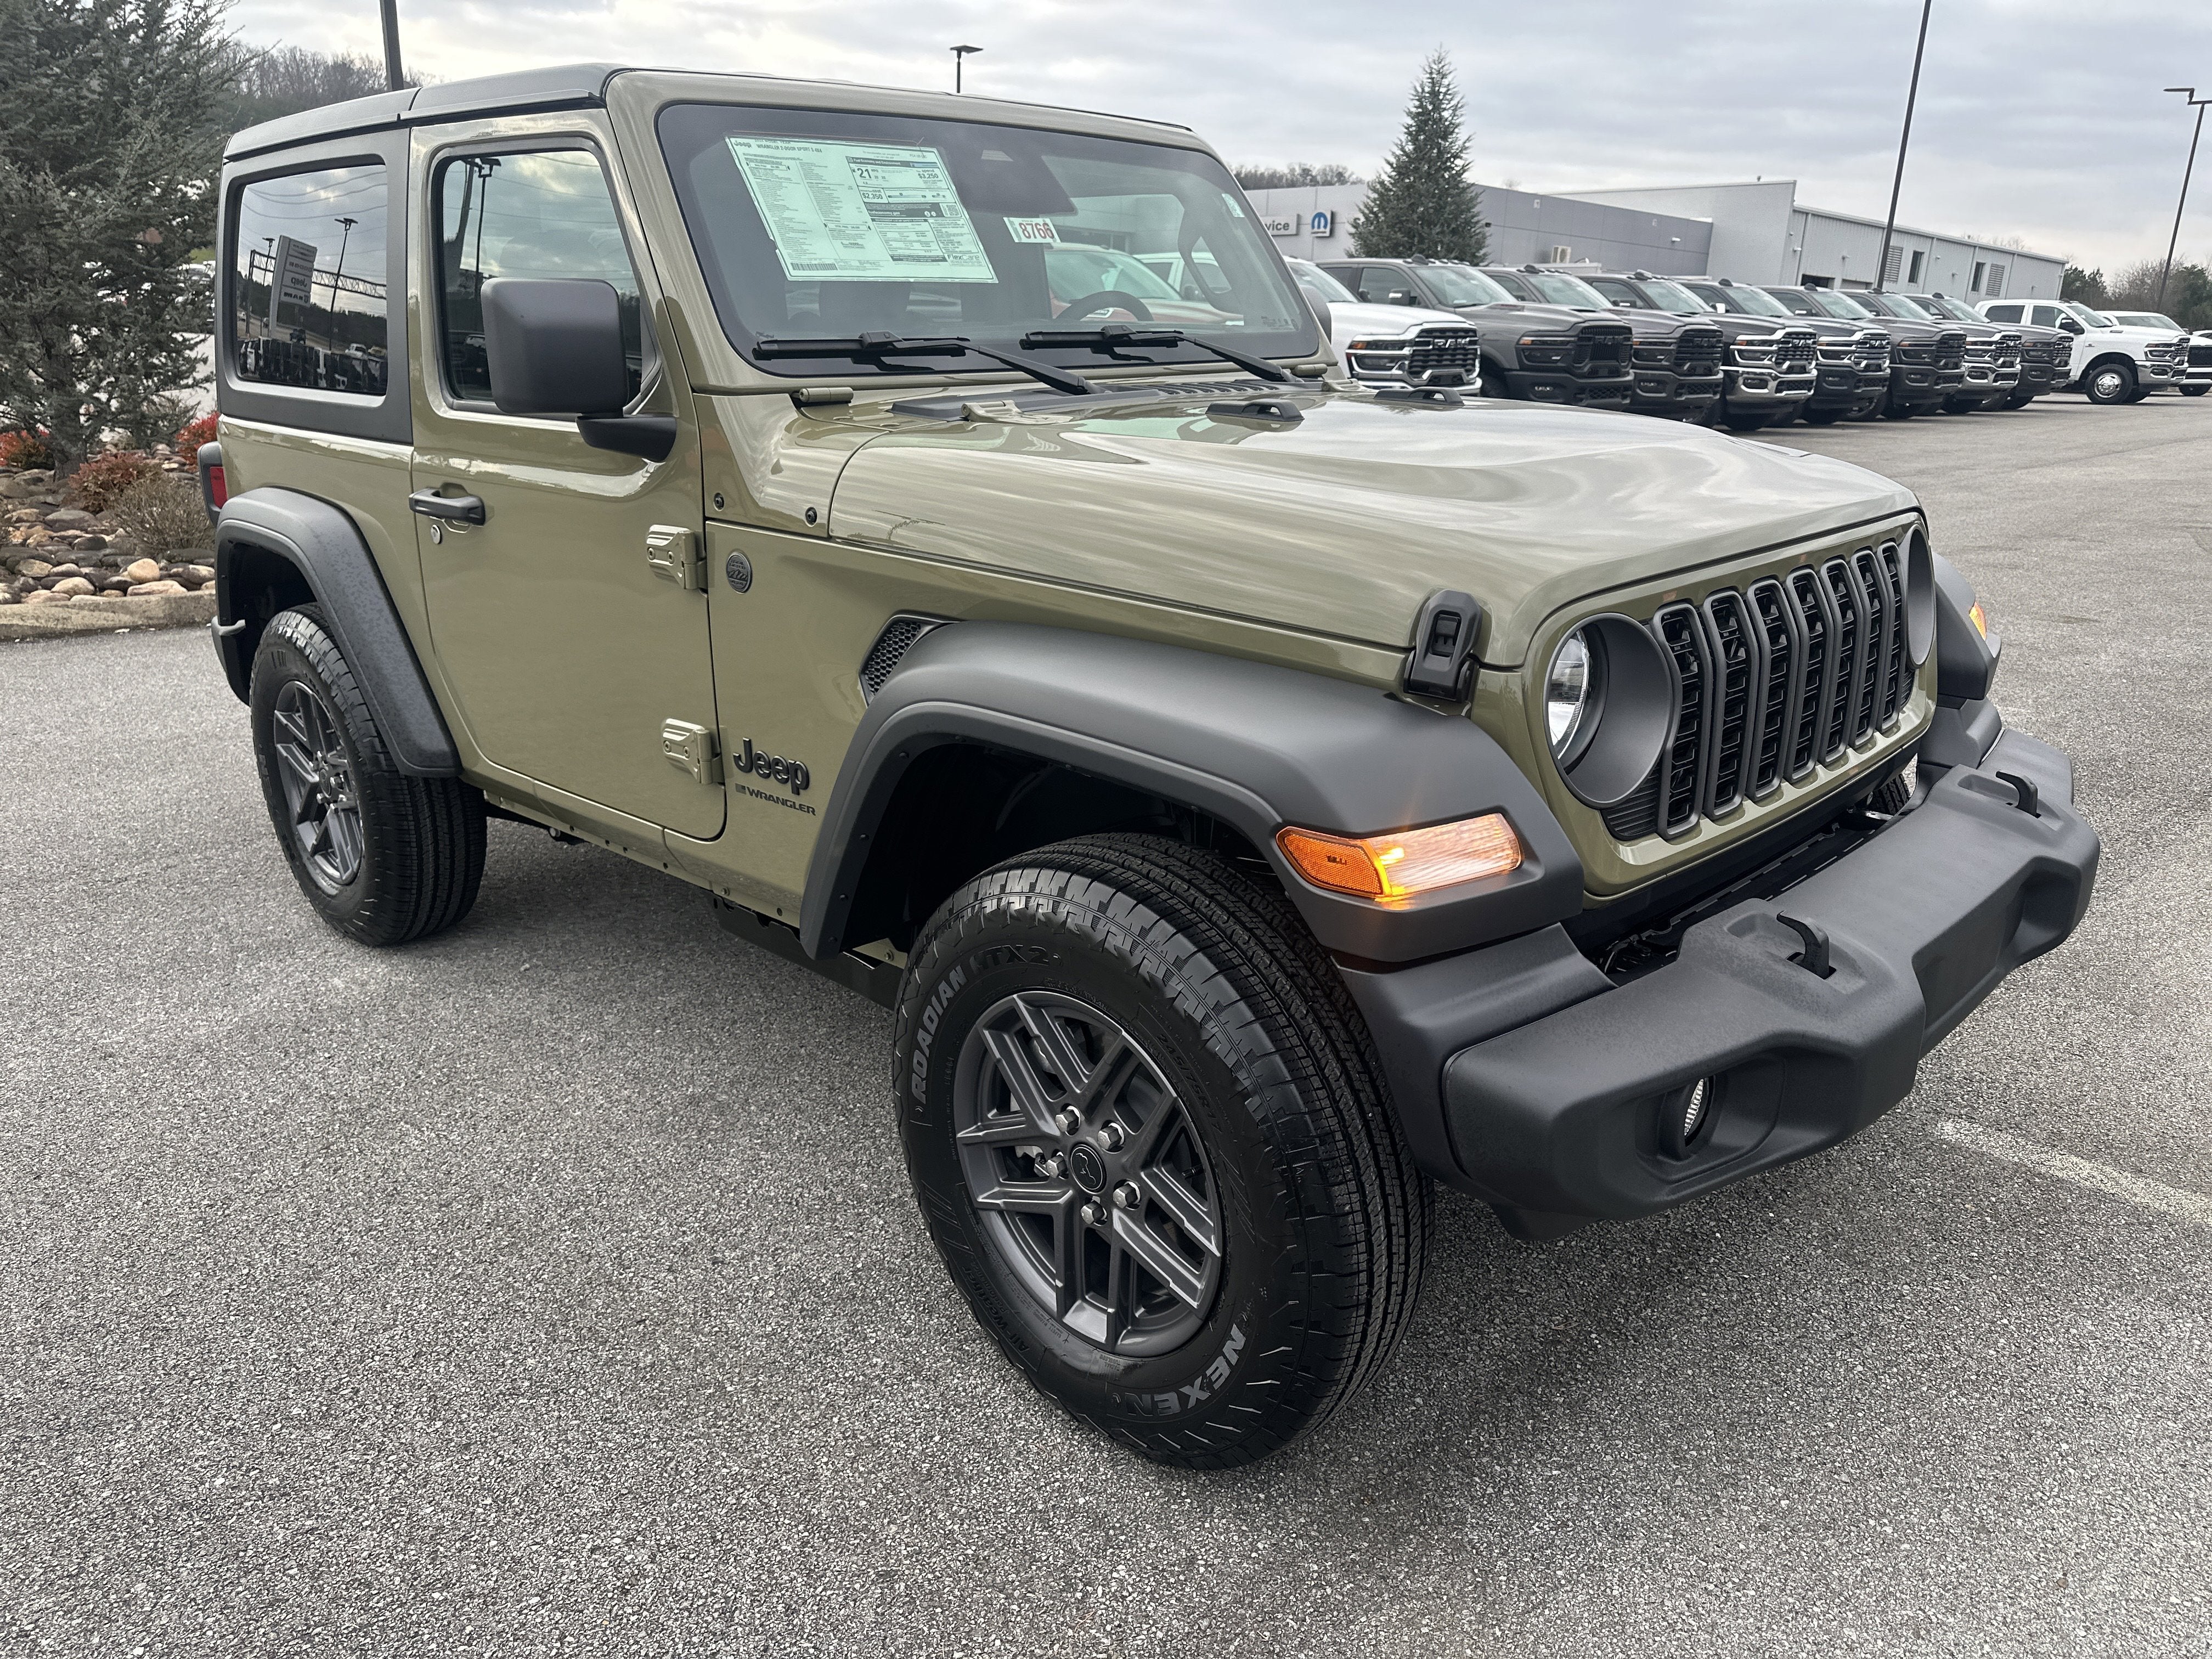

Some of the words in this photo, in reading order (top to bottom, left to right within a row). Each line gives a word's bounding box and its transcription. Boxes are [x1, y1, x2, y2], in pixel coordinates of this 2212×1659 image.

[857, 168, 872, 179] 21
[1019, 222, 1054, 239] 8766
[1434, 337, 1470, 348] RAM
[733, 737, 810, 795] Jeep
[747, 786, 816, 816] WRANGLER
[912, 965, 968, 1104] ROADIAN
[970, 1260, 1006, 1313] Performance
[1125, 1323, 1246, 1417] NEXEN
